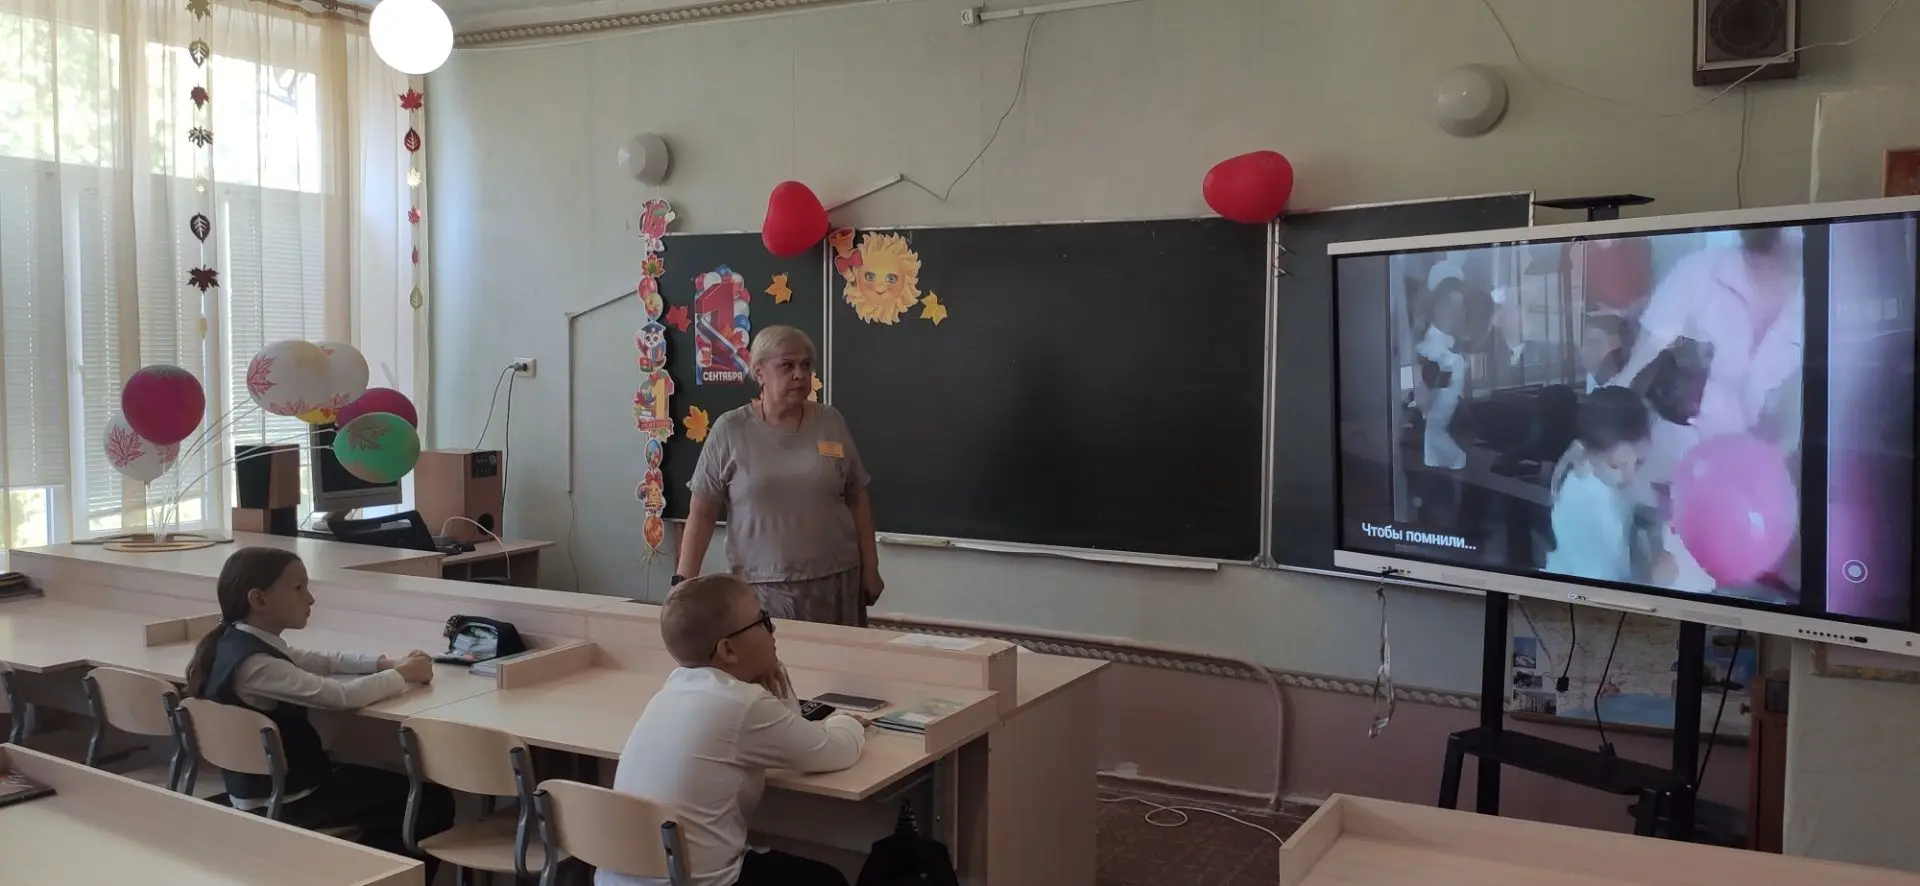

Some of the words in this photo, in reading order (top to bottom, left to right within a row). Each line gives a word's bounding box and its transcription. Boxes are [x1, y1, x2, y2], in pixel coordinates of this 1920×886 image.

[695, 281, 737, 370] 1
[702, 371, 743, 382] СЕНТЯБРЯ
[1361, 522, 1403, 540] Чтобы
[1405, 530, 1477, 550] помнили...
